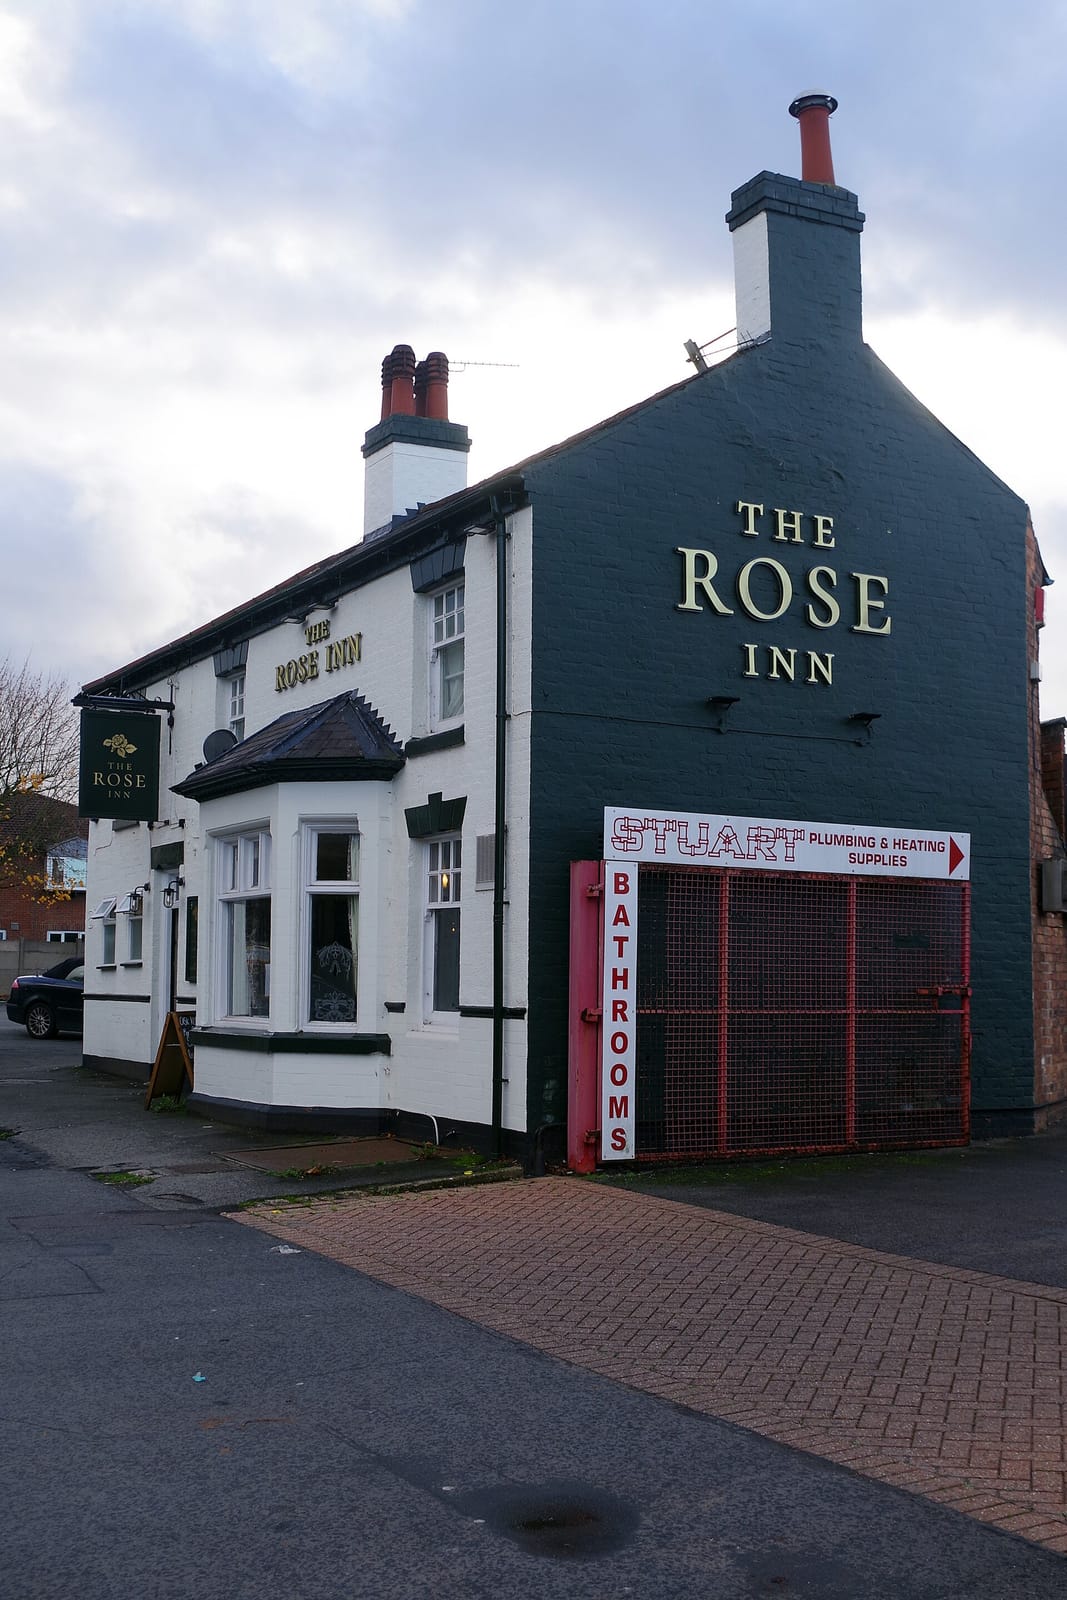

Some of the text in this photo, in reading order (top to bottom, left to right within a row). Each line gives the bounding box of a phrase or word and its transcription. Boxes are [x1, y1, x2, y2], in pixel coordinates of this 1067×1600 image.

[736, 500, 836, 549] THE
[676, 546, 892, 637] ROSE
[304, 619, 331, 646] THE
[274, 632, 363, 693] ROSE INN
[743, 643, 835, 685] INN
[93, 772, 146, 788] ROSE
[107, 761, 133, 771] THE
[107, 790, 131, 799] INN
[610, 816, 805, 862] STUART
[809, 832, 946, 853] PLUMBING & HEATING
[848, 852, 908, 867] SUPPLIES
[608, 872, 631, 1152] BATHROOMS
